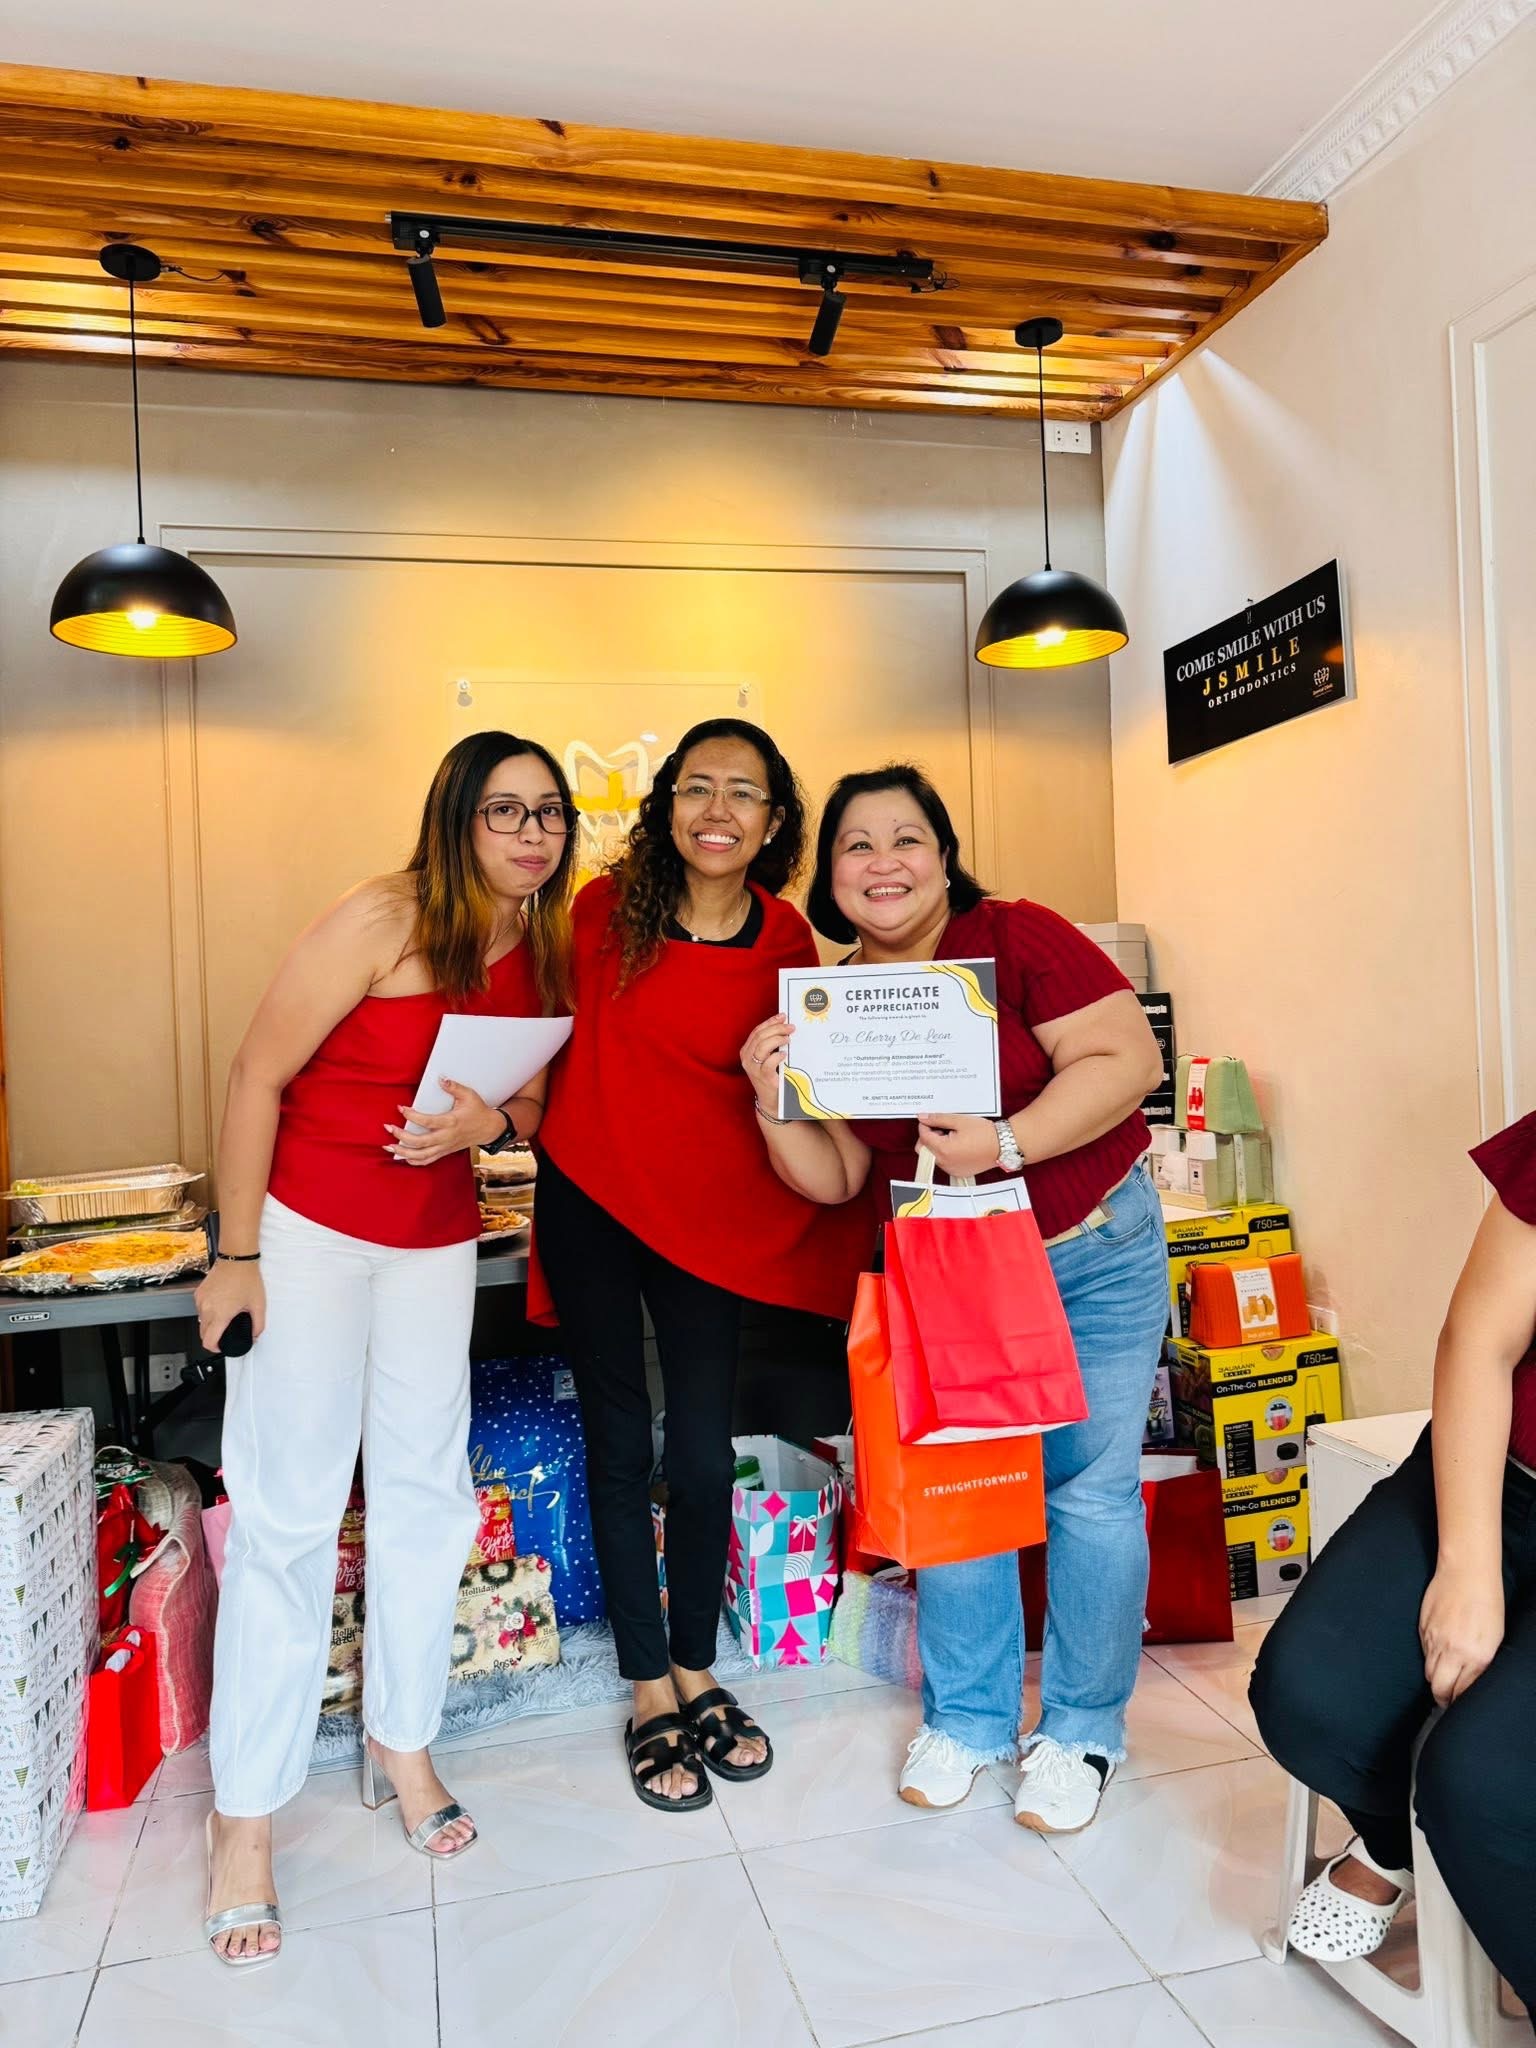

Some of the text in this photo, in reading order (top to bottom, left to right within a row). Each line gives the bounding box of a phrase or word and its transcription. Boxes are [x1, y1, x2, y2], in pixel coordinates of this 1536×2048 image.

[1176, 595, 1326, 682] COME SMILE WITH US
[1208, 662, 1297, 708] ORTHODONTICS
[845, 986, 940, 1001] CERTIFICATE
[846, 1002, 940, 1013] OF APPRECIATION
[855, 1031, 896, 1047] Cherry
[900, 1030, 921, 1042] De
[925, 1028, 952, 1043] Leon
[1172, 1225, 1208, 1234] BAUMANN
[1255, 1219, 1273, 1230] 750
[1170, 1239, 1246, 1254] On-The-Go BLENDER
[1303, 1353, 1321, 1364] 750
[1218, 1363, 1256, 1373] BAUMANN
[1216, 1374, 1294, 1393] On-The-Go BLENDER
[923, 1471, 1028, 1497] STRAIGHTFORWARD
[1223, 1495, 1297, 1514] n-The-Go BLENDER
